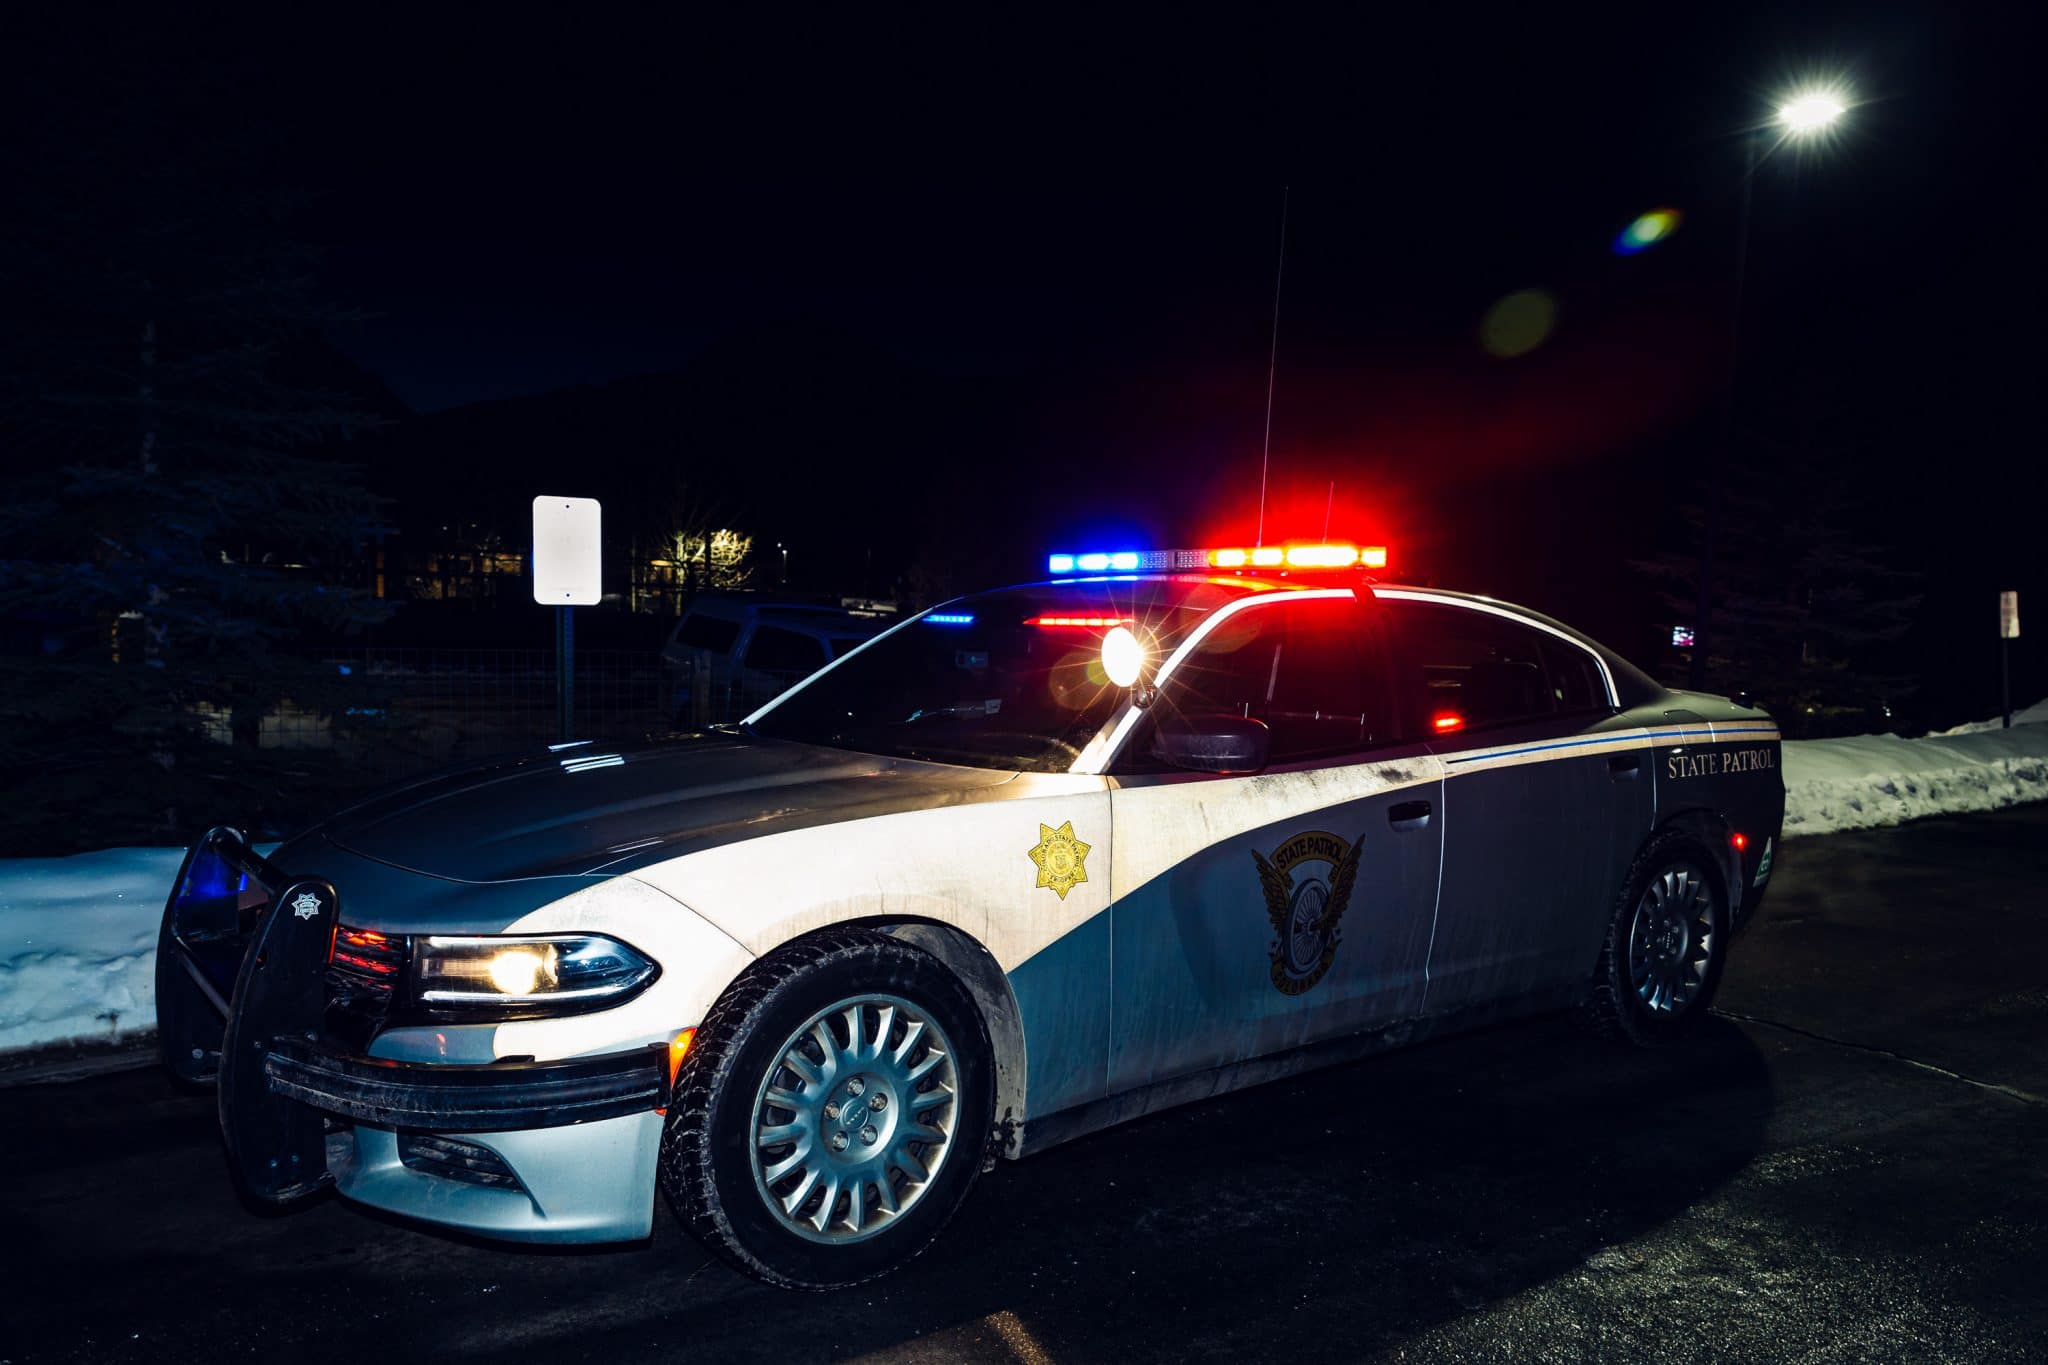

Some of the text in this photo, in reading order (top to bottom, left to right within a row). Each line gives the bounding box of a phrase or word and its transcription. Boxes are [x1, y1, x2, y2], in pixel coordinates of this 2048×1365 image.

[1668, 749, 1775, 778] STATE PATROL
[1276, 838, 1341, 870] STATE PATROL
